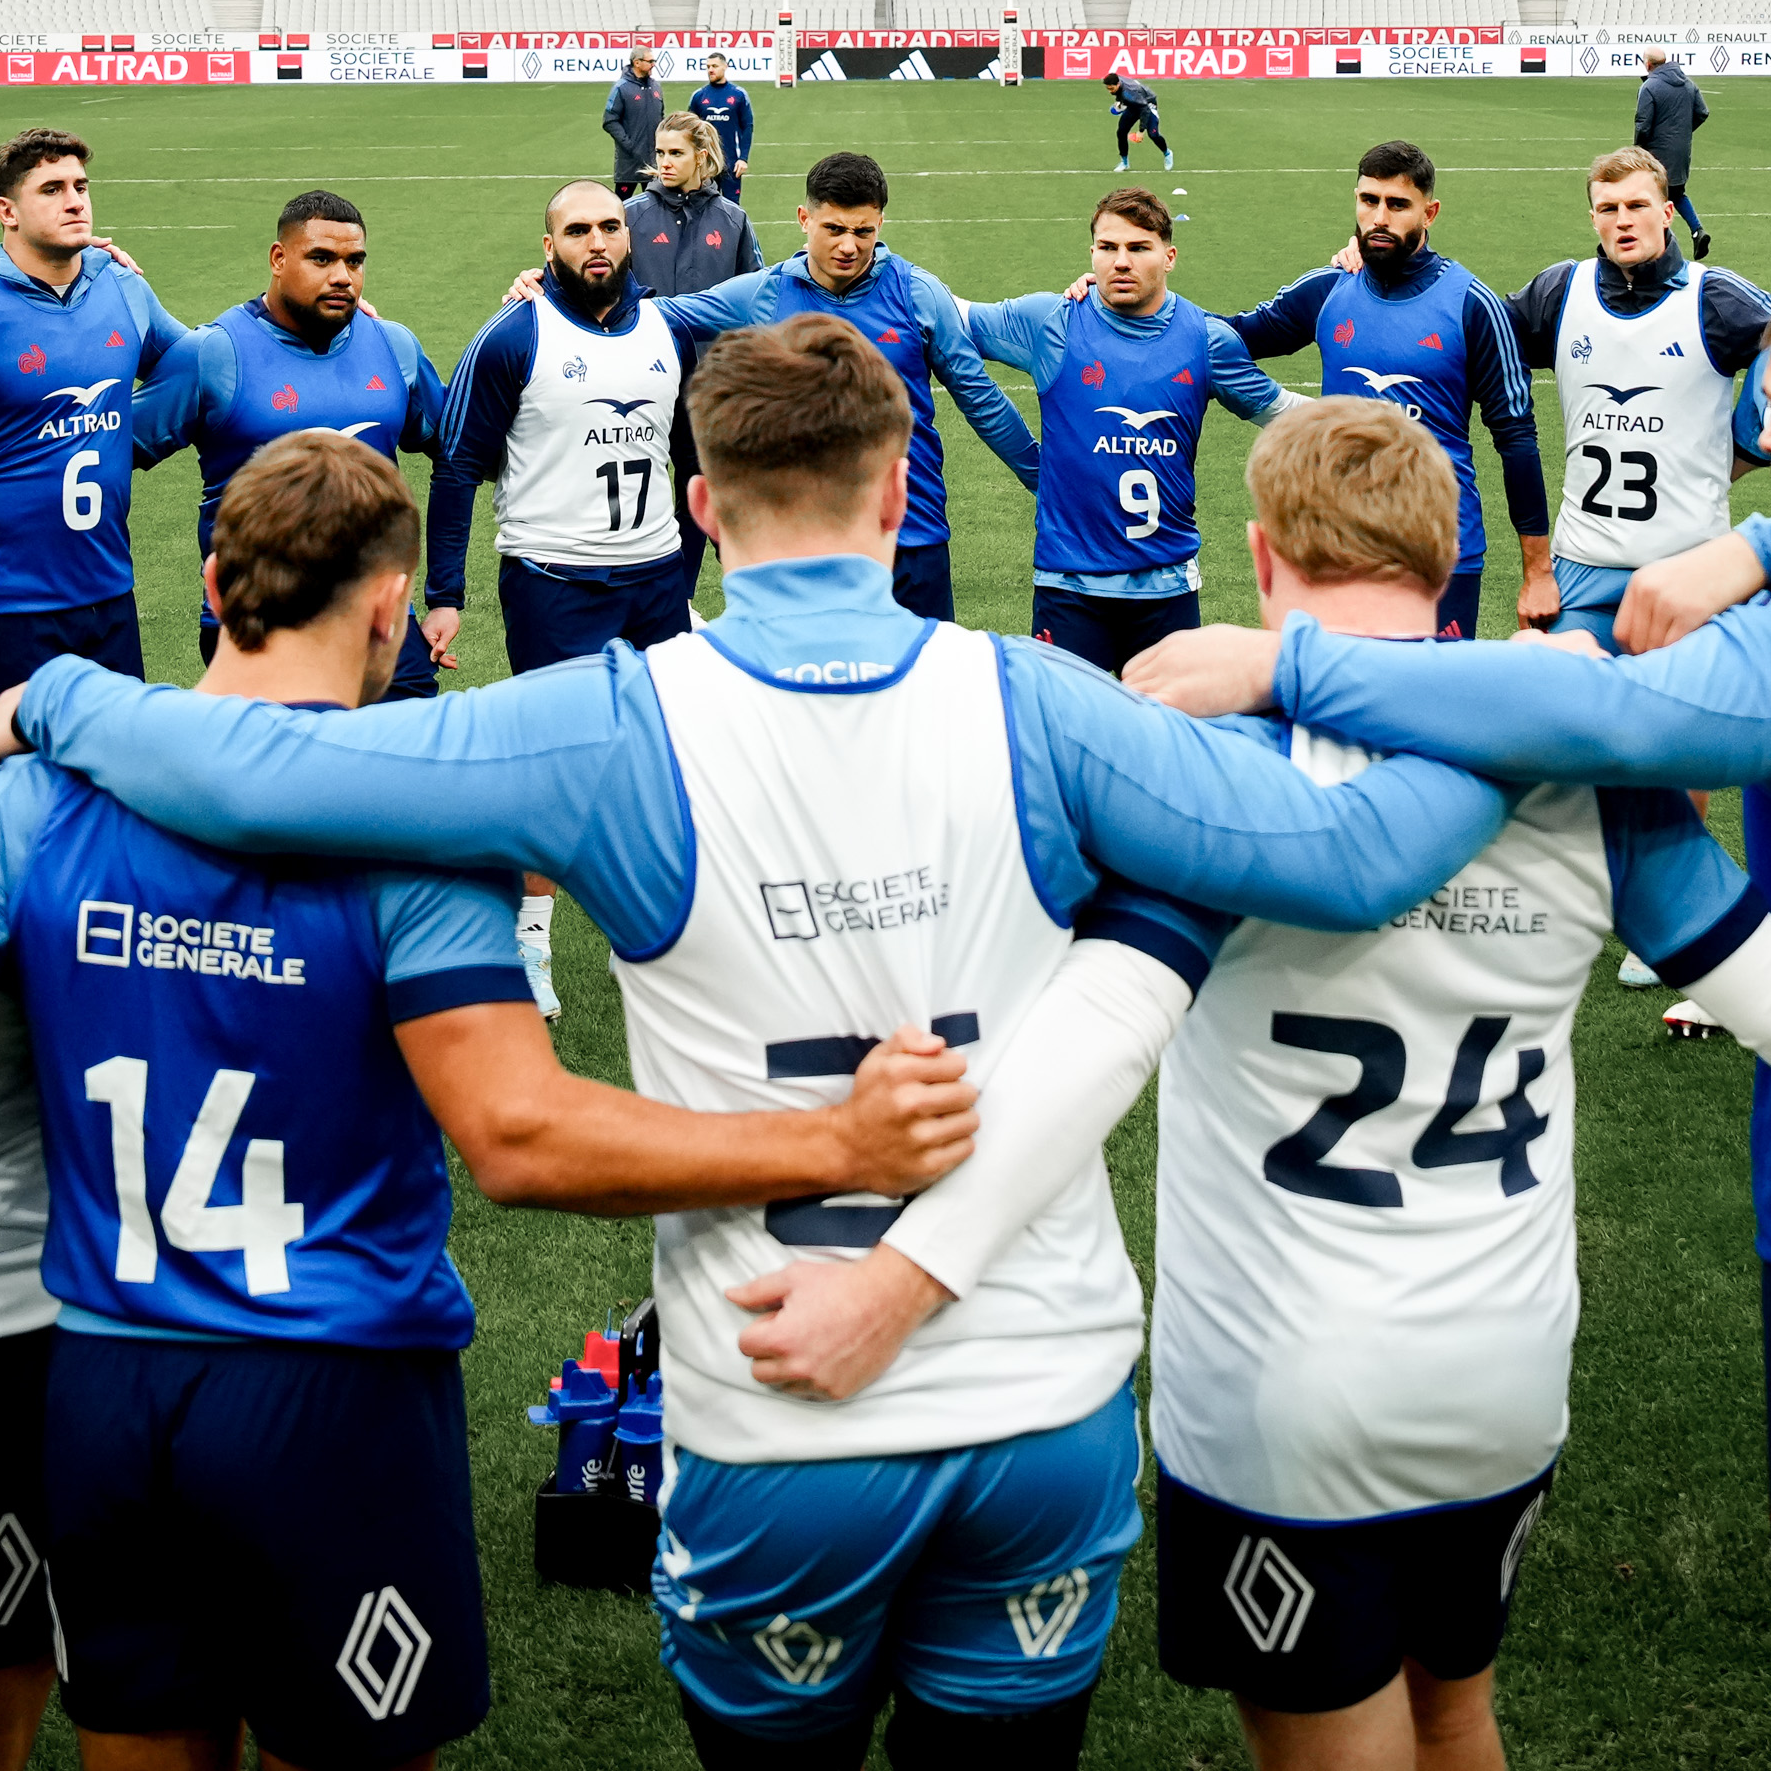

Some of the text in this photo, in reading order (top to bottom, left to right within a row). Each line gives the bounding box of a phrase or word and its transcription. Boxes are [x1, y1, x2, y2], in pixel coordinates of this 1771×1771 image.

[1618, 34, 1677, 43] RENAULT
[1708, 33, 1767, 42] RENAULT
[331, 53, 414, 65] SOCIETE
[1109, 49, 1246, 75] ALTRAD
[1390, 47, 1473, 59] SOCIETE
[52, 55, 188, 80] ALTRAD
[330, 68, 434, 80] GENERALE
[1389, 63, 1492, 74] GENERALE
[38, 411, 120, 439] ALTRAD
[1583, 413, 1663, 432] ALTRAD
[584, 426, 654, 445] ALTRAD
[1093, 436, 1176, 456] ALTRAD
[63, 450, 102, 530] 6
[596, 458, 652, 531] 17
[1581, 445, 1657, 521] 23
[1119, 470, 1160, 539] 9
[137, 912, 274, 955] SOCIETE
[137, 942, 305, 984] GENERALE
[1264, 1010, 1549, 1207] 24
[85, 1056, 304, 1296] 14
